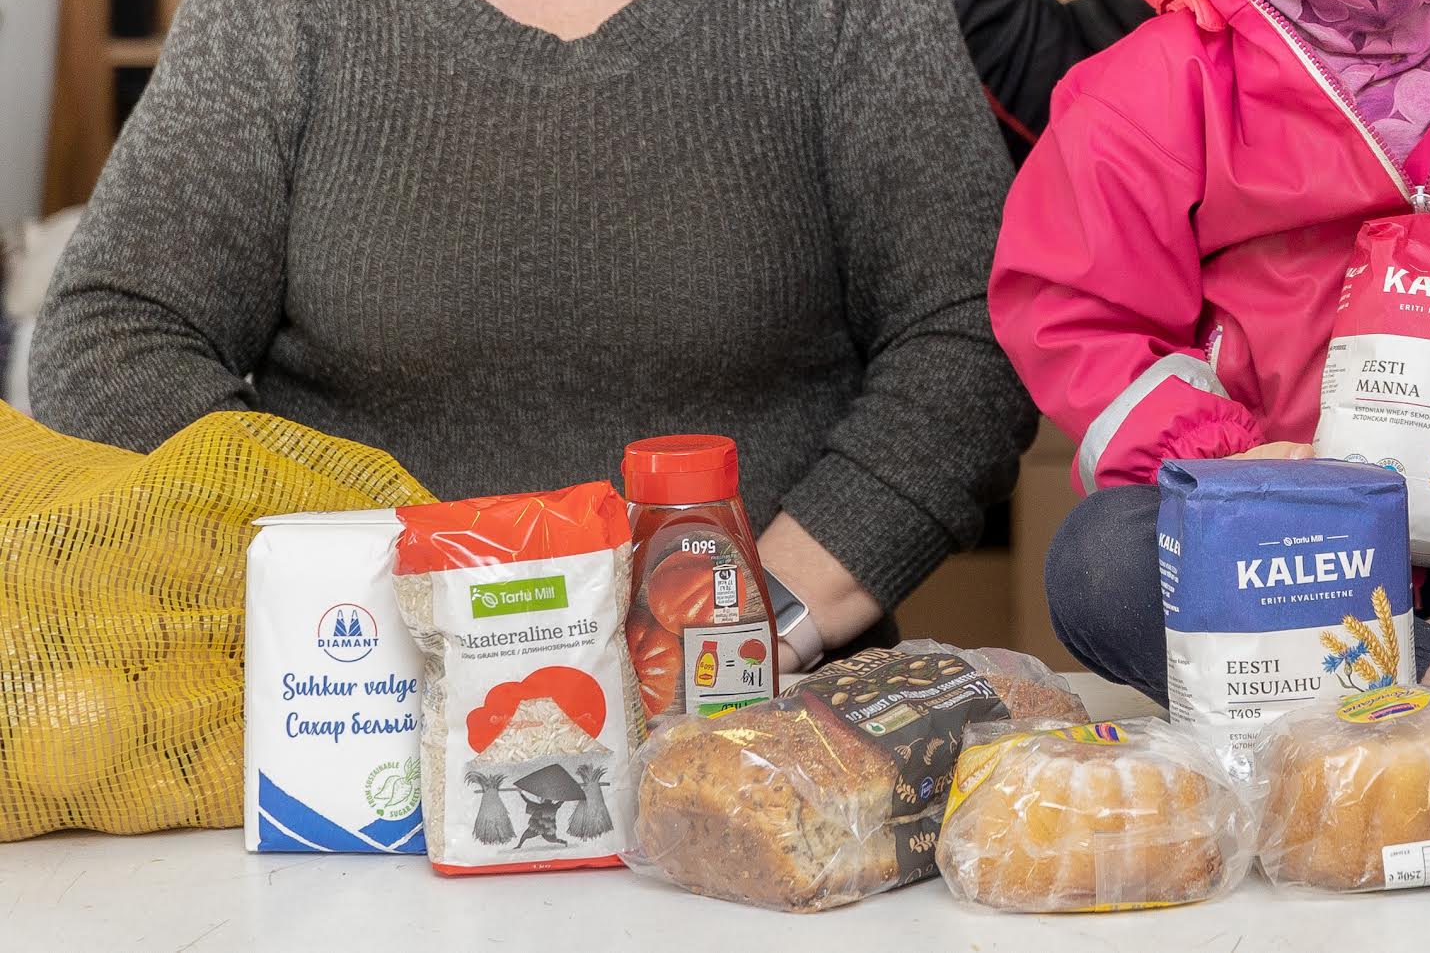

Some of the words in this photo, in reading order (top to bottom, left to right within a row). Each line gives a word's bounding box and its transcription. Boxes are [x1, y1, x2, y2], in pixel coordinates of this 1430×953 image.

[1399, 303, 1424, 313] ERITI
[1361, 360, 1406, 375] EESTI
[1356, 379, 1420, 397] MANNA
[1236, 548, 1376, 590] KALEW
[499, 591, 533, 604] Tartu
[534, 586, 555, 600] Mill
[1261, 597, 1286, 606] ERITI
[1291, 589, 1354, 603] KVALITEETNE
[567, 618, 598, 636] riis
[318, 638, 379, 648] DIAMANT
[581, 638, 596, 647] РИС
[476, 650, 499, 660] GRAIN
[500, 649, 516, 657] RICE
[1226, 659, 1280, 675] EESTI
[282, 672, 358, 701] Suhkur
[363, 673, 418, 703] valge
[1227, 676, 1321, 696] NISUJAHU
[1228, 708, 1261, 719] T405
[285, 711, 346, 743] Сахар
[351, 711, 418, 735] белый
[365, 761, 400, 788] SUSTAINABLE
[390, 805, 412, 817] SUGAR
